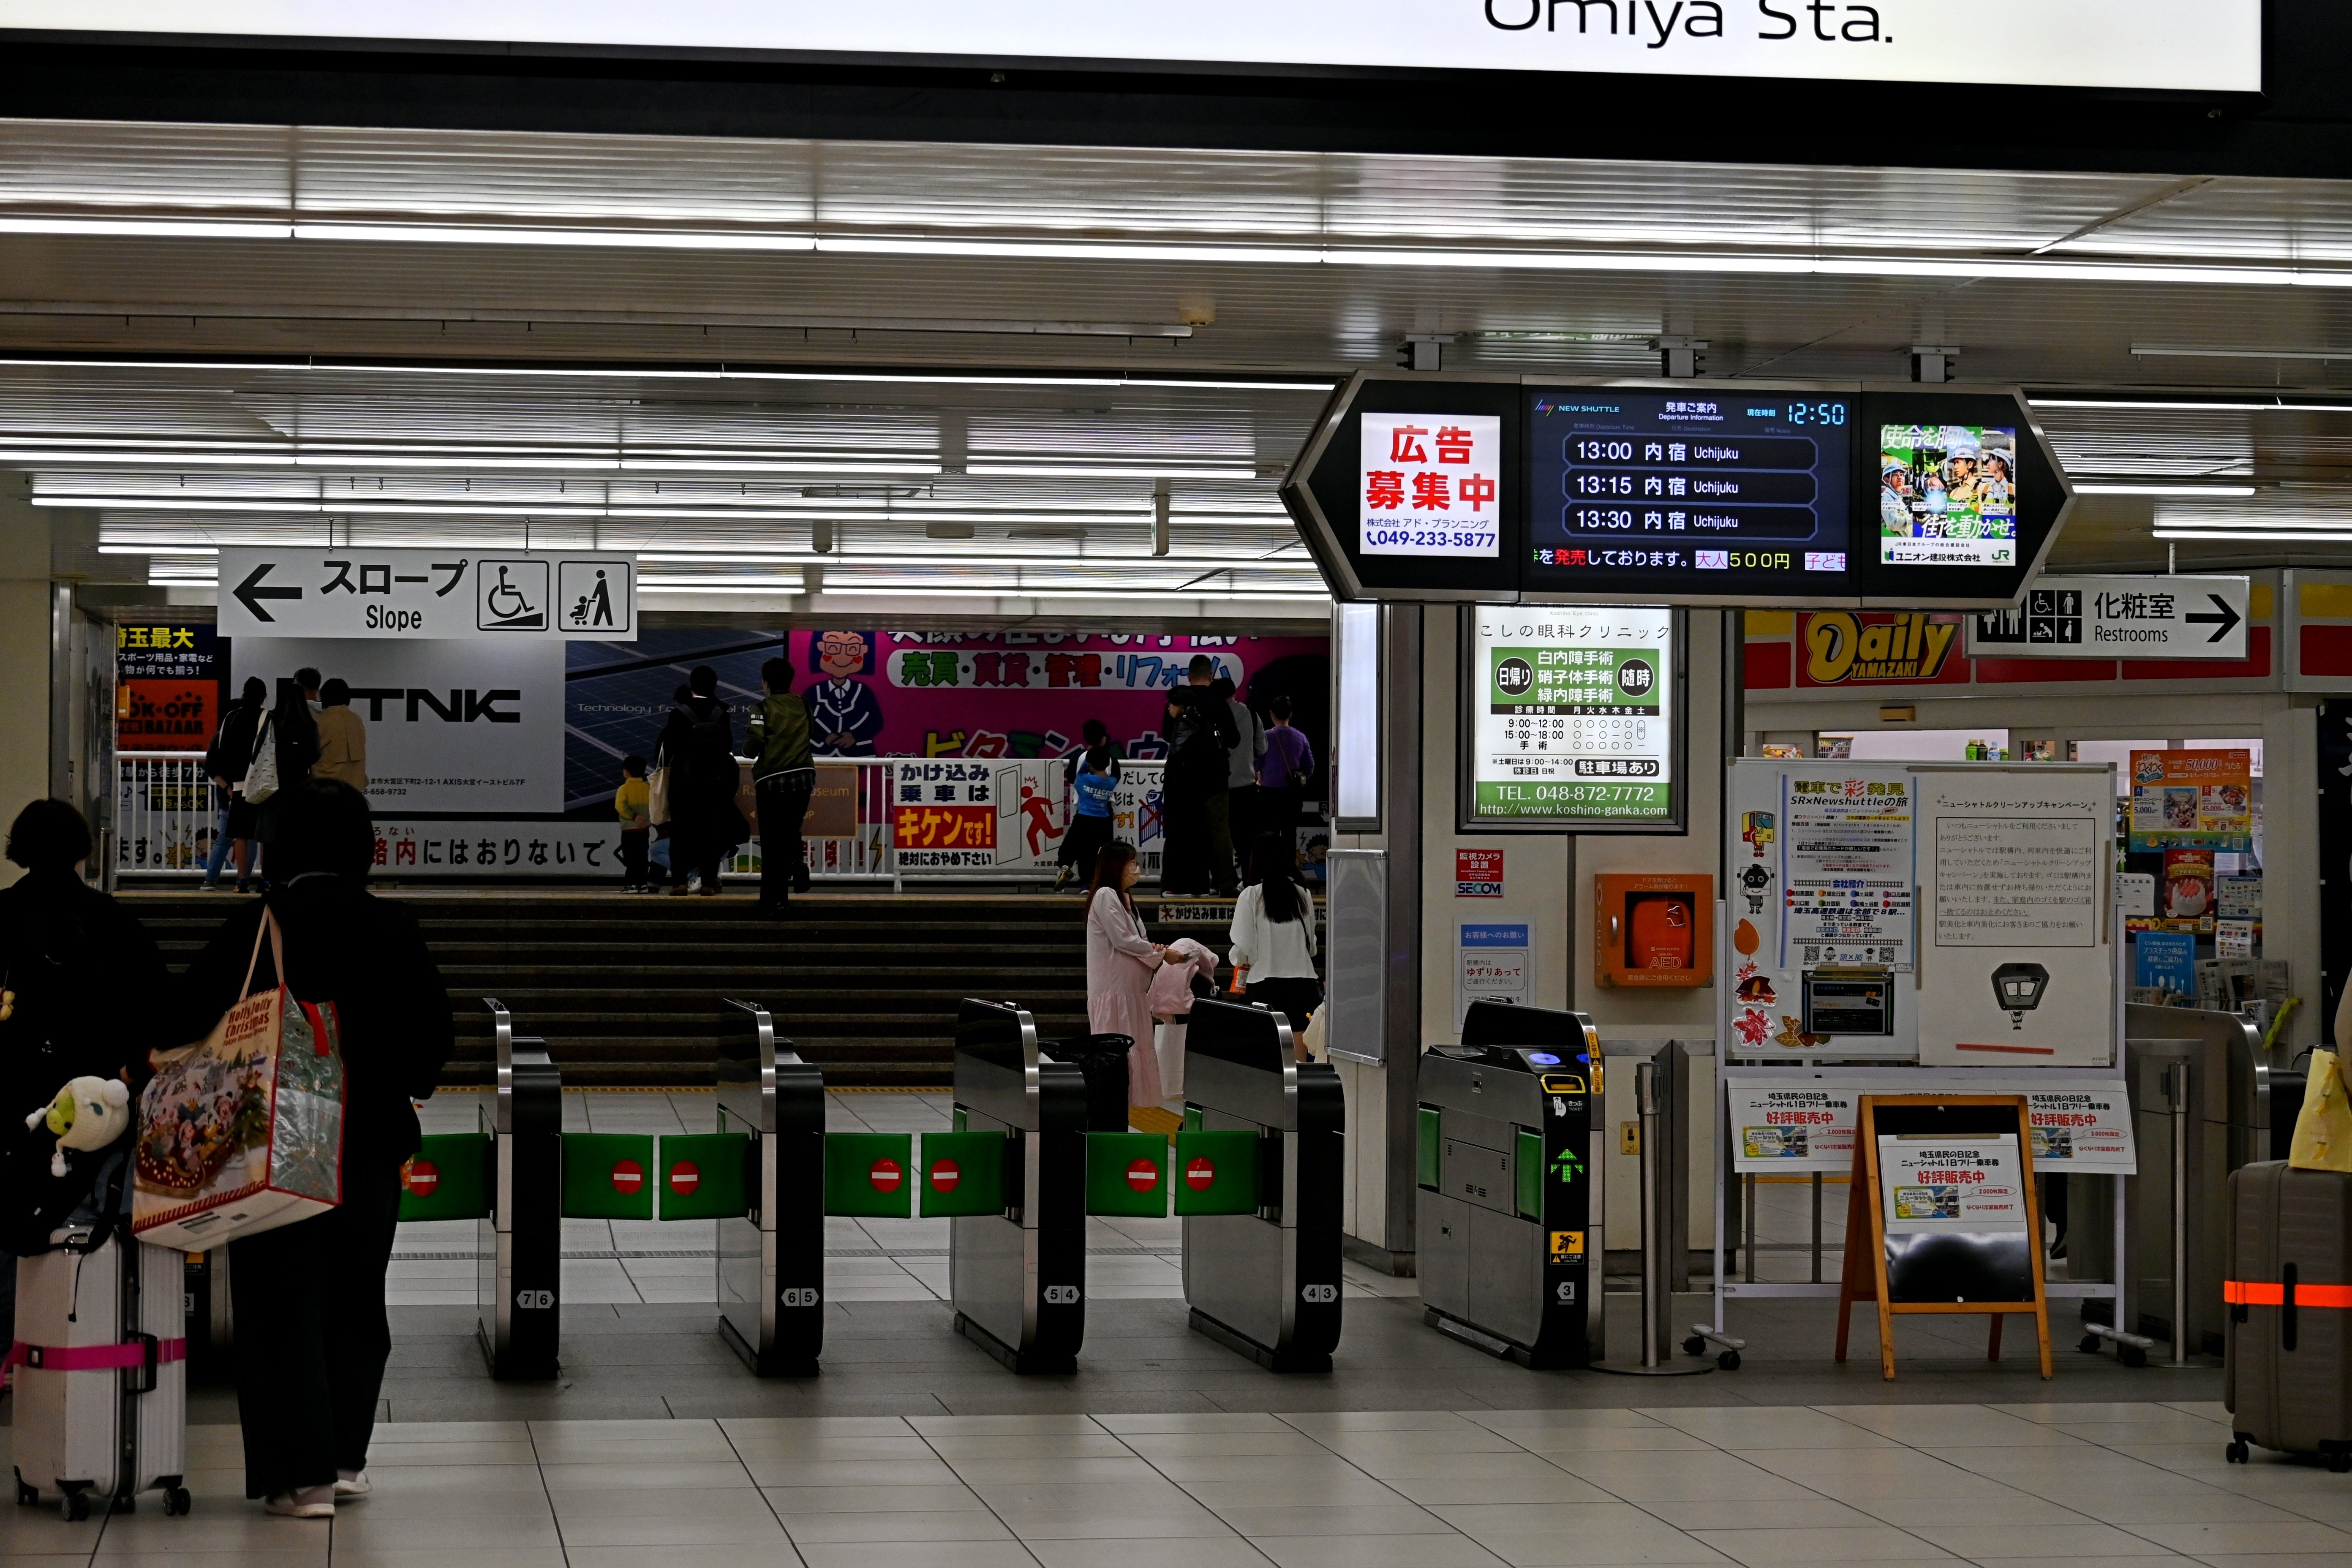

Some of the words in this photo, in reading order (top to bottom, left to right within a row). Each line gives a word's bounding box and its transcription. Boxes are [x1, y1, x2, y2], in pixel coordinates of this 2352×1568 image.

[1484, 0, 1722, 48] Omiya
[1759, 0, 1892, 43] Sta.
[1666, 402, 1717, 414] 発車ご案内
[1747, 409, 1775, 417] 現在時刻
[1788, 403, 1844, 425] 12:50
[1881, 425, 1980, 449] 使命を胸に。
[1390, 425, 1473, 464] 広告
[1577, 441, 1632, 460] 13:00
[1645, 442, 1686, 461] 内宿
[1694, 446, 1738, 461] Uchijuku
[1366, 471, 1494, 512] 募集中
[1577, 476, 1632, 494] 13:15
[1645, 477, 1686, 495] 内宿
[1694, 481, 1738, 495] Uchijuku
[1367, 518, 1400, 527] 株式会社
[1403, 519, 1489, 529] アド・プランニング
[1577, 510, 1631, 528] 13:30
[1645, 511, 1685, 530] 内宿
[1693, 515, 1738, 530] Uchijuku
[1921, 514, 2016, 539] 街を動かせ。
[1377, 531, 1496, 547] 049-233-5877
[1895, 553, 1981, 562] ユニオン建設株式会社
[1991, 550, 2010, 560] JR
[320, 559, 468, 597] スロープ
[2094, 592, 2175, 619] 化粧室
[366, 604, 422, 632] Slope
[1481, 624, 1669, 639] こしの眼科クリニック
[2095, 625, 2168, 642] Restrooms
[1806, 612, 1955, 681] Daily
[1538, 651, 1614, 666] 白内障手術
[901, 651, 1231, 688] 売買・賃貸・管理・リフォム
[1852, 662, 1917, 678] YAMAZAKI
[1499, 667, 1531, 686] 日帰り
[1538, 670, 1614, 685] 硝子体手術
[1621, 668, 1650, 687] 随時
[1537, 688, 1613, 703] 緑内障手術
[577, 703, 651, 715] Technology
[1514, 706, 1555, 714] 診療時間
[1573, 706, 1581, 715] 月
[1587, 706, 1594, 715] 火
[1599, 706, 1607, 715] 水
[1612, 706, 1620, 715] 木
[1624, 707, 1633, 715] 金
[145, 720, 204, 734] BAZAAR
[901, 764, 989, 781] かけ込み
[1579, 761, 1656, 775] 駐車場あり
[901, 785, 989, 802] 乗車は
[1496, 786, 1531, 800] TEL.
[1536, 786, 1654, 801] 048-872-7772
[1794, 780, 1905, 798] 電車で彩発見
[1480, 803, 1668, 816] http://www.koshino-ganka.com
[1942, 801, 2088, 809] ニューシャトルクリーンアップキャンペーン
[898, 808, 991, 847] キケンです!
[1947, 822, 2078, 830] いつもニューシャトルをご利用くださいまして
[1939, 834, 2003, 842] ありがとうございます。
[1939, 847, 2092, 855] ニューシャトルでは駅構内、列車内を快適にご利
[898, 852, 991, 866] 絶対におやめ下さい
[1939, 859, 2091, 867] 用していただくため「ニューシャトルクリーンアップ
[1939, 871, 2092, 879] キャンペーン」を実施しております。ゴミは駅構内ま
[1458, 883, 1501, 894] SECOM
[1833, 880, 1865, 888] 会社紹介
[1939, 884, 2092, 892] たは車内に放置せずお持ち帰りいただくようにお
[1939, 896, 2091, 904] 願いいたします。また、家庭内のゴミを駅のゴミ箱
[1939, 908, 2030, 916] へ捨てるのはお止めください。
[1939, 920, 2083, 928] 駅美化と車内美化にお客さまのご協力をお願い
[1649, 957, 1682, 969] AED
[1467, 967, 1521, 977] ゆずりあって
[1766, 1111, 1834, 1124] 好評販売中
[2031, 1113, 2097, 1127] 好評販売中
[1917, 1171, 1985, 1184] 好評販売中
[788, 1293, 796, 1302] 6
[804, 1292, 812, 1302] 5
[1050, 1289, 1058, 1299] 5
[1065, 1289, 1073, 1299] 4
[1308, 1288, 1316, 1298] 4
[1324, 1288, 1331, 1298] 3
[1563, 1285, 1571, 1296] 3
[523, 1295, 531, 1304] 7
[540, 1295, 548, 1304] 6
